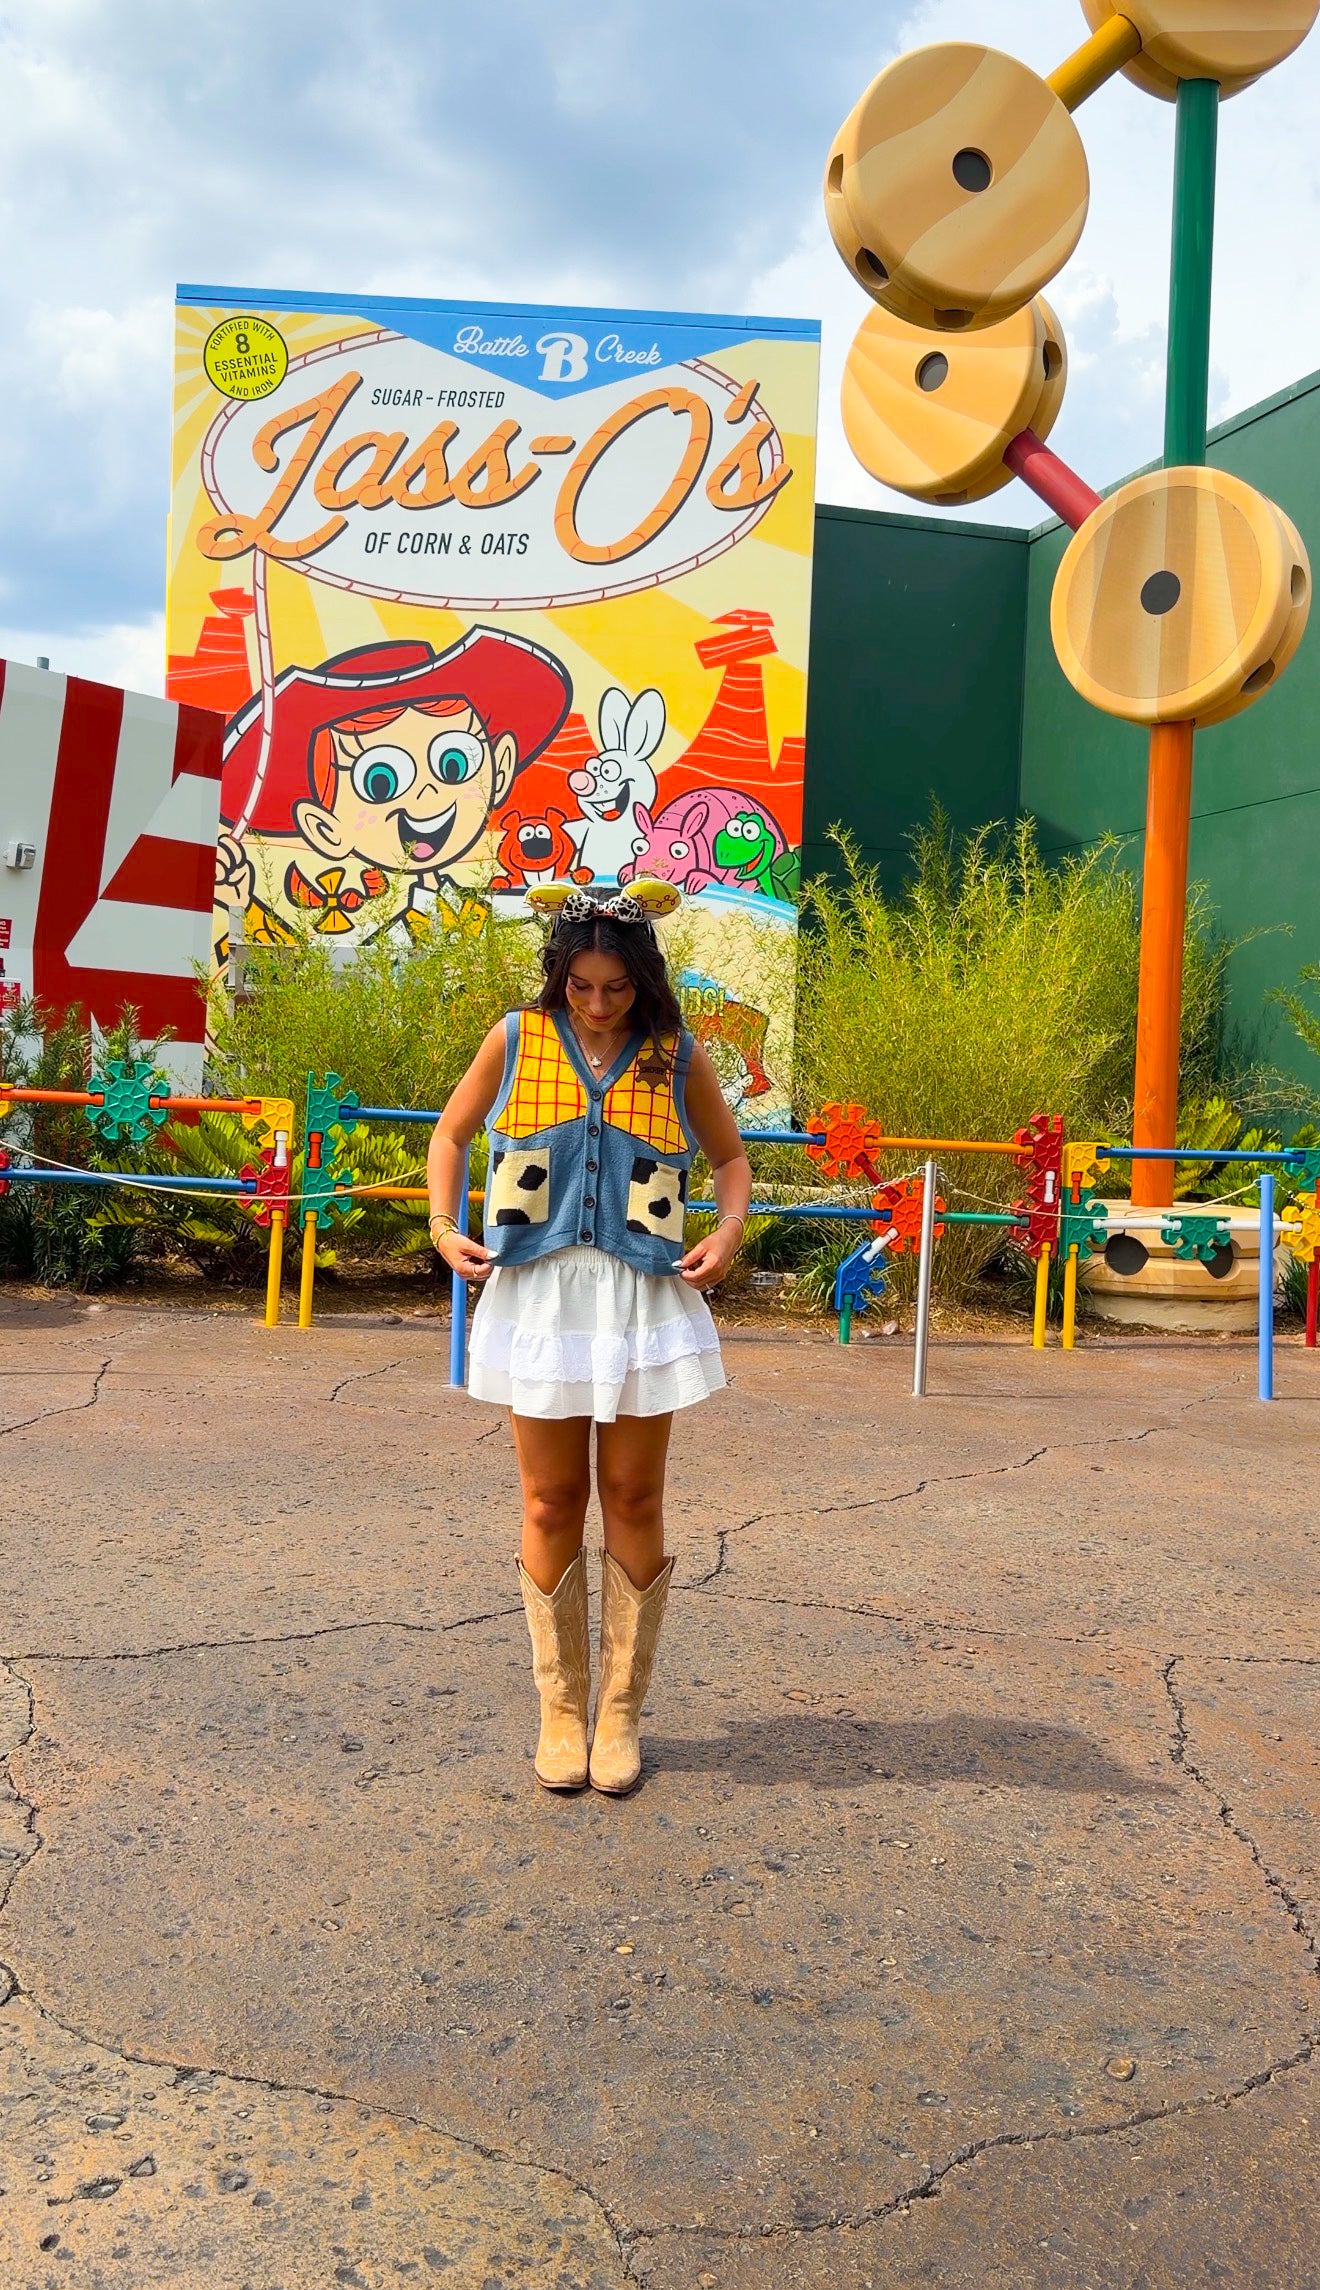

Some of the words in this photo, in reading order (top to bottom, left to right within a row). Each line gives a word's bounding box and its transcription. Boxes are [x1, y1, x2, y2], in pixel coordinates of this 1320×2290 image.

[210, 320, 249, 351] FORTIFIED
[252, 322, 275, 341] WITH
[235, 333, 250, 354] 8
[214, 352, 278, 372] ESSENTIAL
[453, 325, 530, 358] Battle
[535, 332, 589, 383] B
[594, 334, 662, 366] Creek
[220, 364, 276, 382] VITAMINS
[229, 385, 249, 397] AND
[251, 378, 274, 396] IRON
[364, 531, 391, 554] OF
[396, 532, 452, 555] CORN
[458, 534, 472, 555] &
[480, 533, 530, 555] OATS
[679, 985, 725, 1017] IDS!
